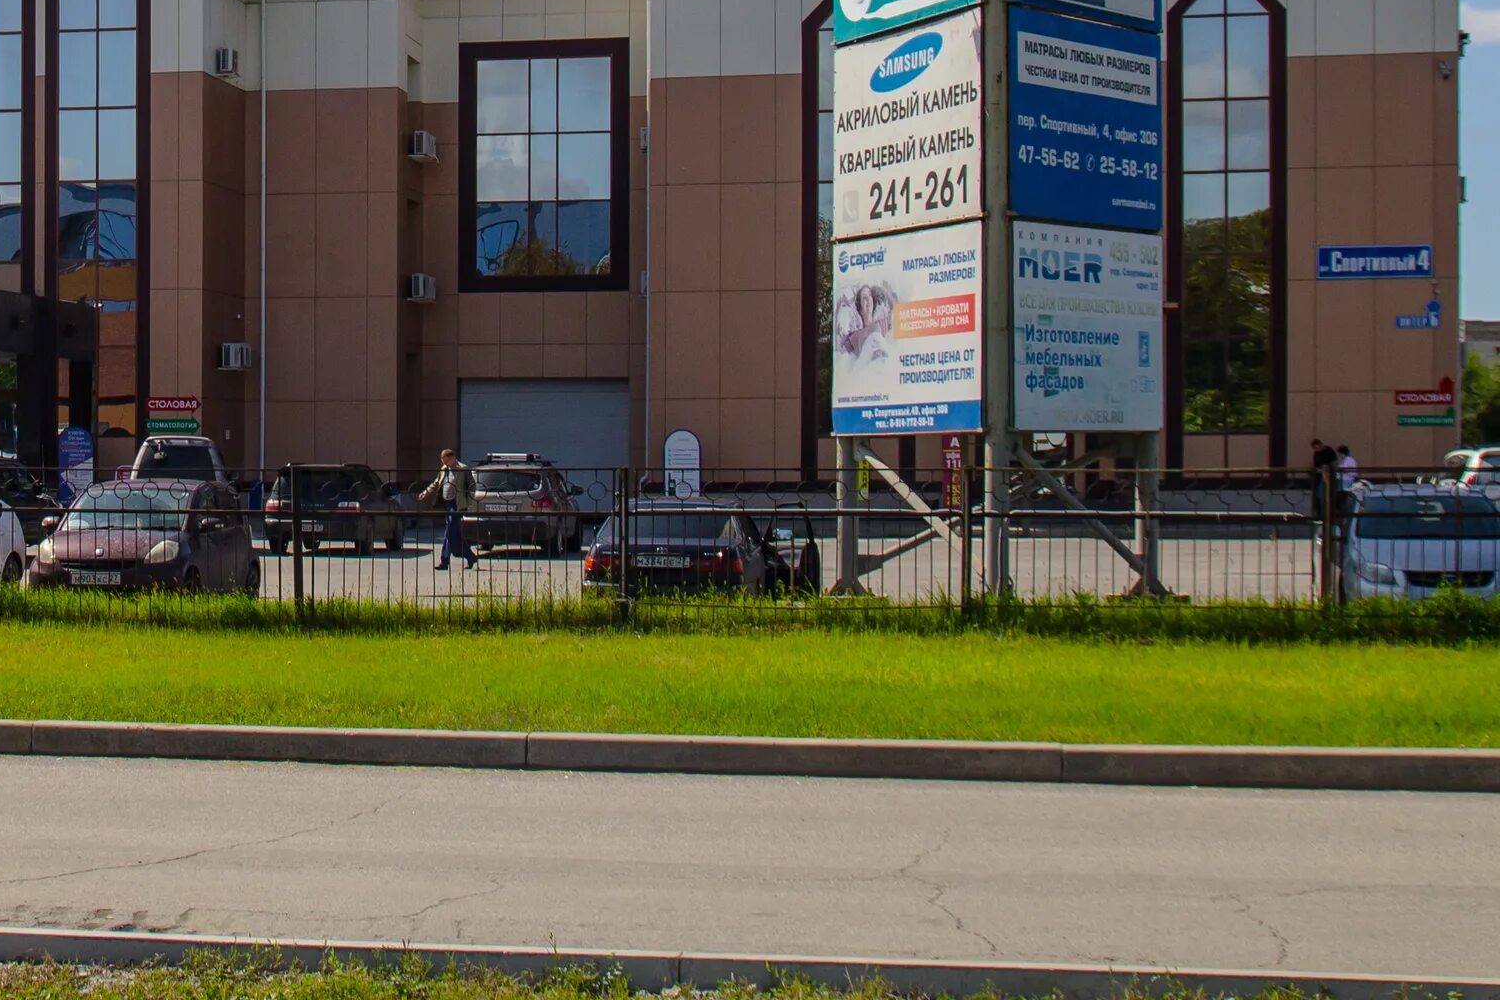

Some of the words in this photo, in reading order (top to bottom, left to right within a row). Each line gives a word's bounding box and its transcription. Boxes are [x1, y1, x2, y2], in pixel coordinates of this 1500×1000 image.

[879, 47, 934, 78] SAMSUNG
[1024, 40, 1068, 60] МАТРАСЫ
[1070, 49, 1104, 67] ЛЮБЫХ
[1107, 55, 1151, 76] РАЗМЕРОВ
[1025, 63, 1057, 81] ЧЕСТНАЯ
[1059, 69, 1079, 84] ЦЕНА
[1081, 74, 1090, 85] ОТ
[1092, 76, 1151, 97] ПРОИЗВОДИТЕЛЯ
[837, 91, 919, 134] АКРИЛОВЫЙ
[923, 80, 978, 114] КАМЕНЬ
[1018, 114, 1038, 131] пер.
[1040, 114, 1100, 139] Спортивный,
[1102, 123, 1113, 142] 4,
[1115, 128, 1138, 144] офис
[1140, 130, 1158, 145] 306
[839, 134, 916, 175] КВАРЦЕВЫЙ
[920, 126, 975, 160] КАМЕНЬ
[1018, 144, 1080, 170] 47-56-62
[1100, 155, 1158, 180] 25-58-12
[870, 164, 968, 220] 241-261
[1018, 230, 1103, 247] КОМПАНИЯ
[902, 254, 941, 271] МАТРАСЫ
[943, 249, 977, 267] ЛЮБЫХ
[1019, 247, 1103, 284] MOER
[1417, 249, 1430, 271] 4
[929, 267, 976, 284] РАЗМЕРОВ!
[900, 307, 932, 319] МАТРАСЫ
[936, 302, 969, 316] КРОВАТИ
[941, 318, 954, 329] ДЛЯ
[955, 316, 970, 327] СНА
[1025, 323, 1120, 346] Изготовление
[899, 352, 936, 367] ЧЕСТНАЯ
[938, 349, 961, 365] ЦЕНА
[964, 348, 975, 361] ОТ
[1025, 347, 1102, 367] мебельных
[899, 366, 975, 384] ПРОИЗВОДИТЕЛЯ!
[1025, 370, 1085, 393] фасадов
[148, 399, 198, 409] СТОЛОВАЯ
[146, 421, 198, 429] СТОМАТОЛОГИЯ
